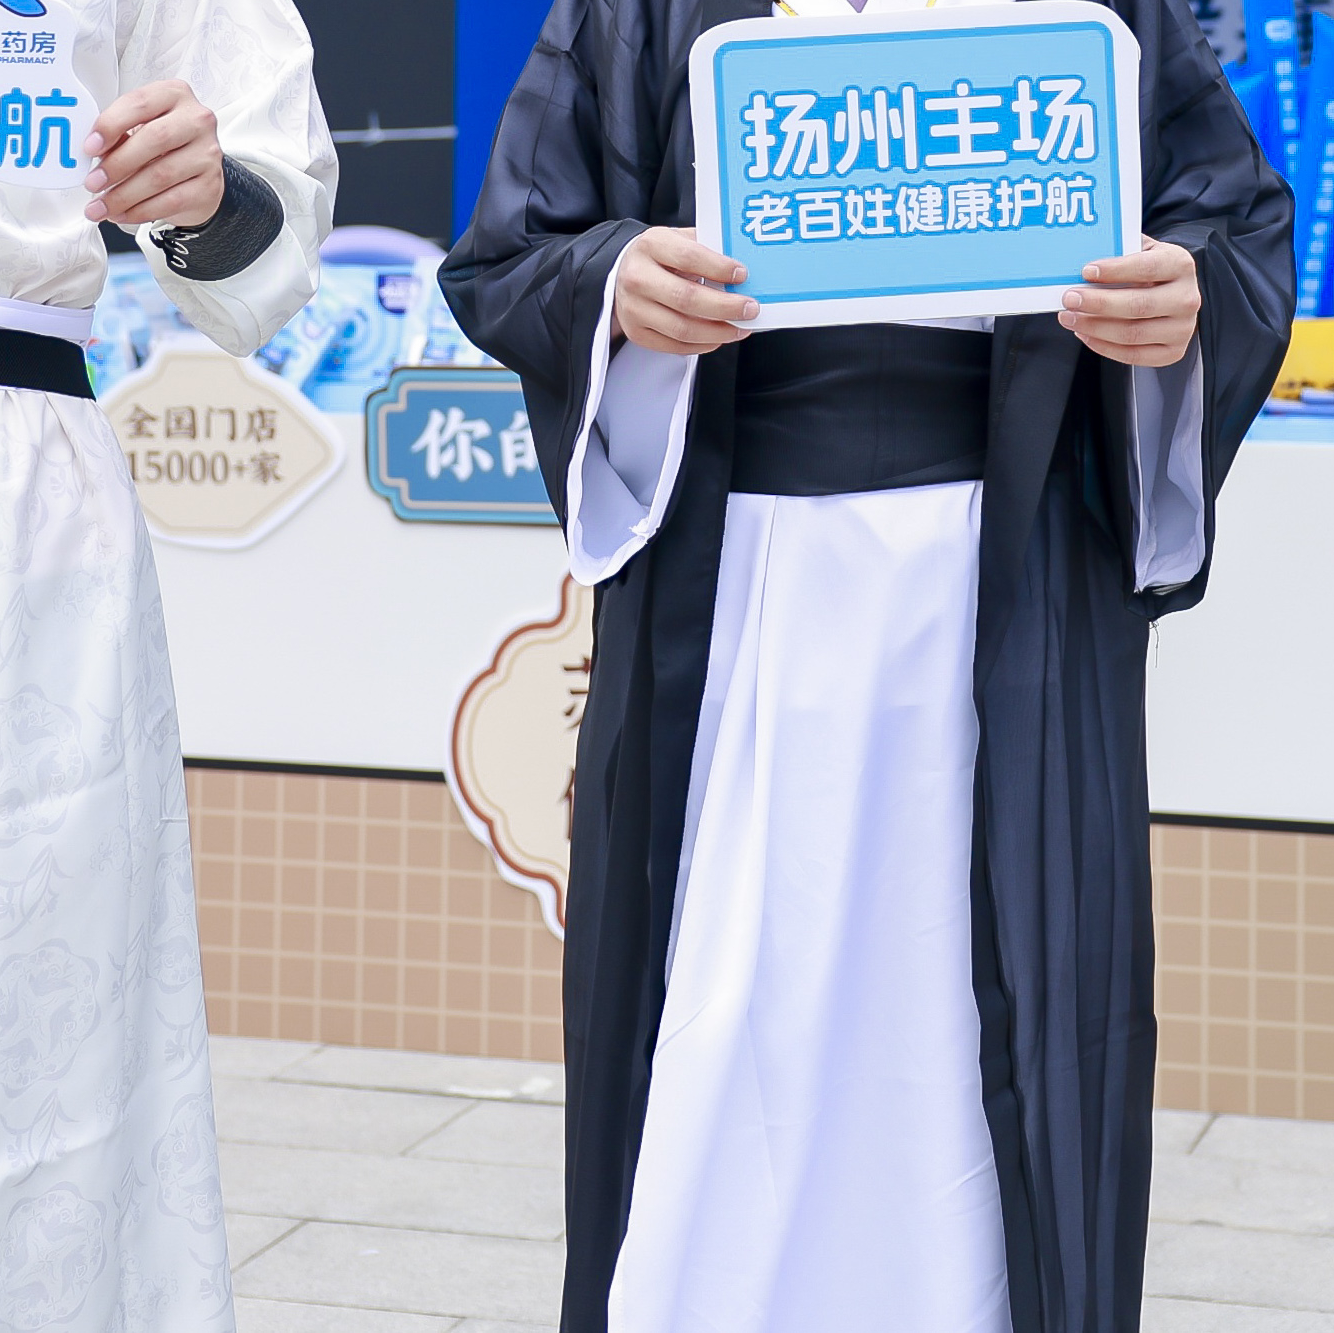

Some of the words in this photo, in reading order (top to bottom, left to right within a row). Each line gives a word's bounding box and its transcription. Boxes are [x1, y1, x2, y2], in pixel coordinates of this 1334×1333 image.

[742, 77, 1097, 179] 扬州主场
[744, 174, 1095, 243] 老百姓健康护航
[125, 404, 279, 443] 全国门店
[127, 449, 282, 485] 15000+家
